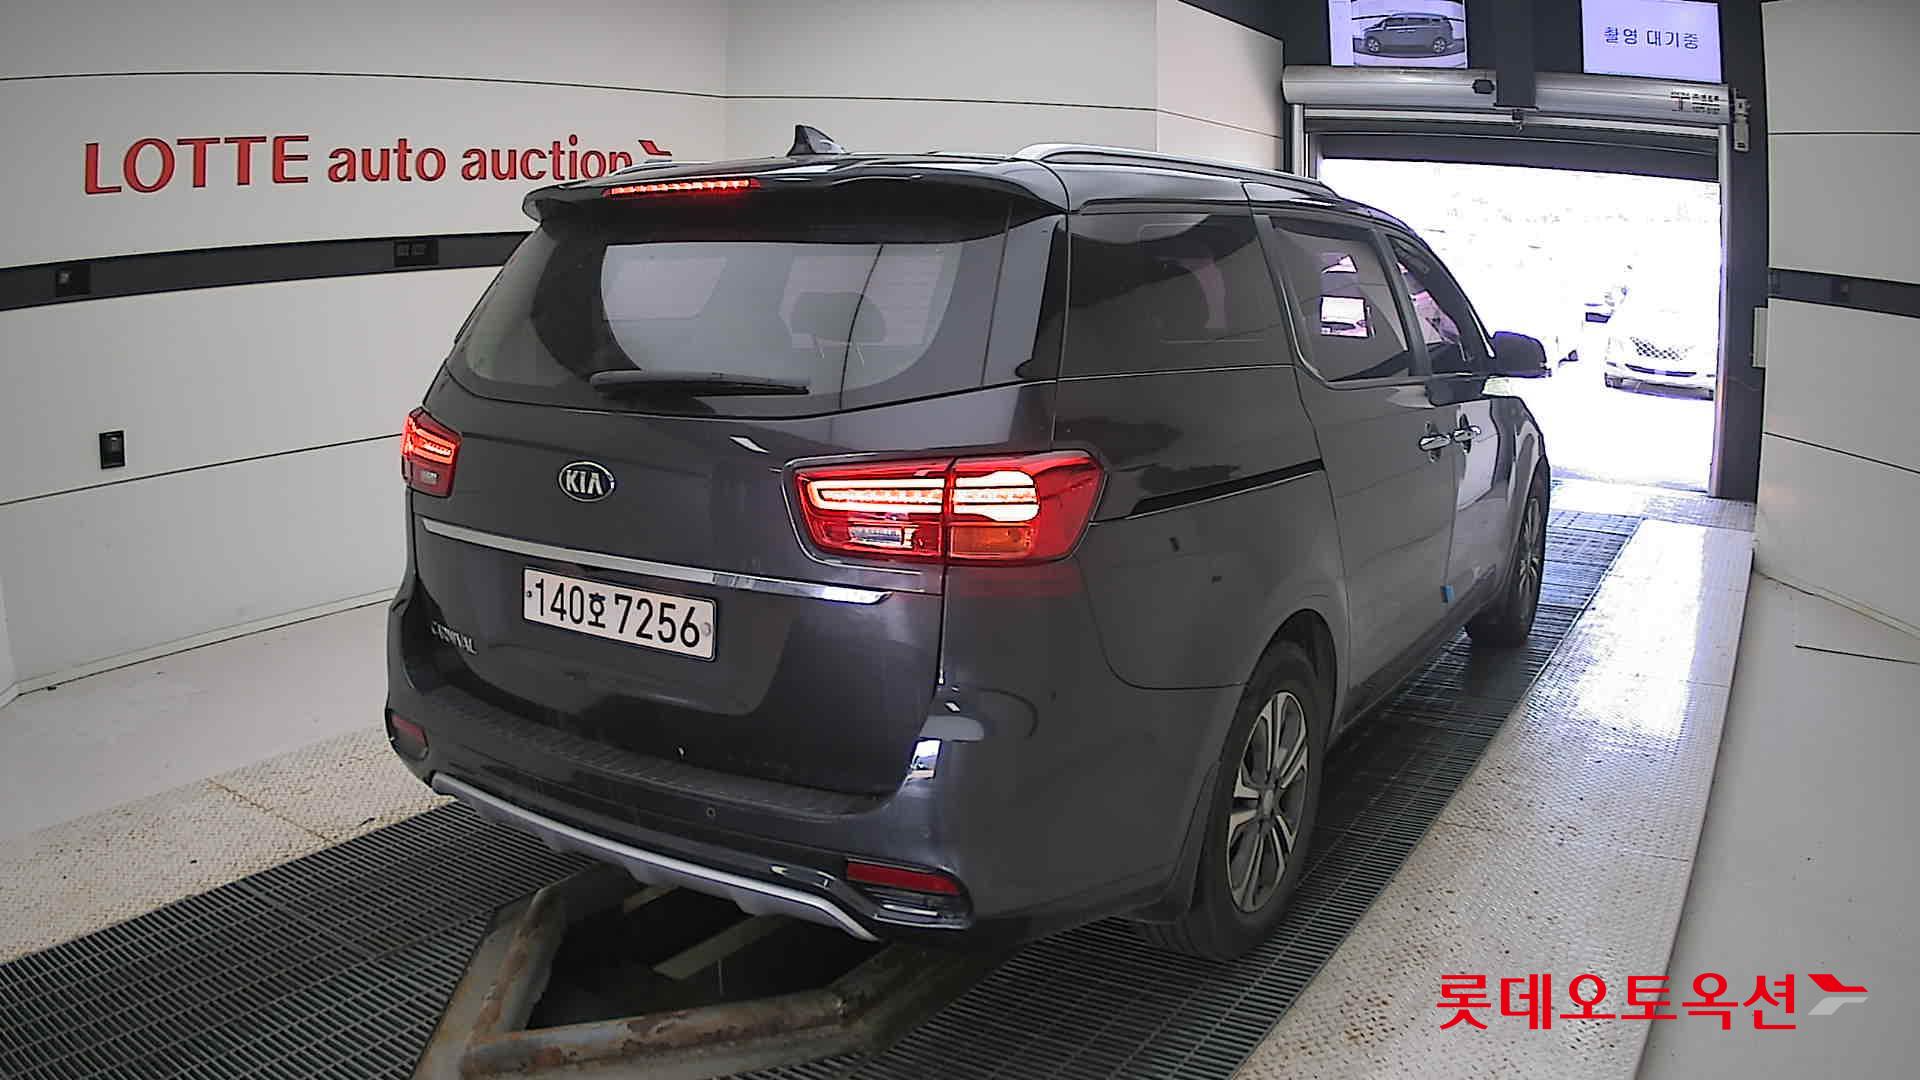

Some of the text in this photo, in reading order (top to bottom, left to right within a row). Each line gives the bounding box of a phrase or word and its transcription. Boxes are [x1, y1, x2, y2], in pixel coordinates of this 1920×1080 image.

[1646, 30, 1698, 49] 대기중
[84, 134, 633, 195] LOTTE auto auction
[566, 469, 603, 495] KIA
